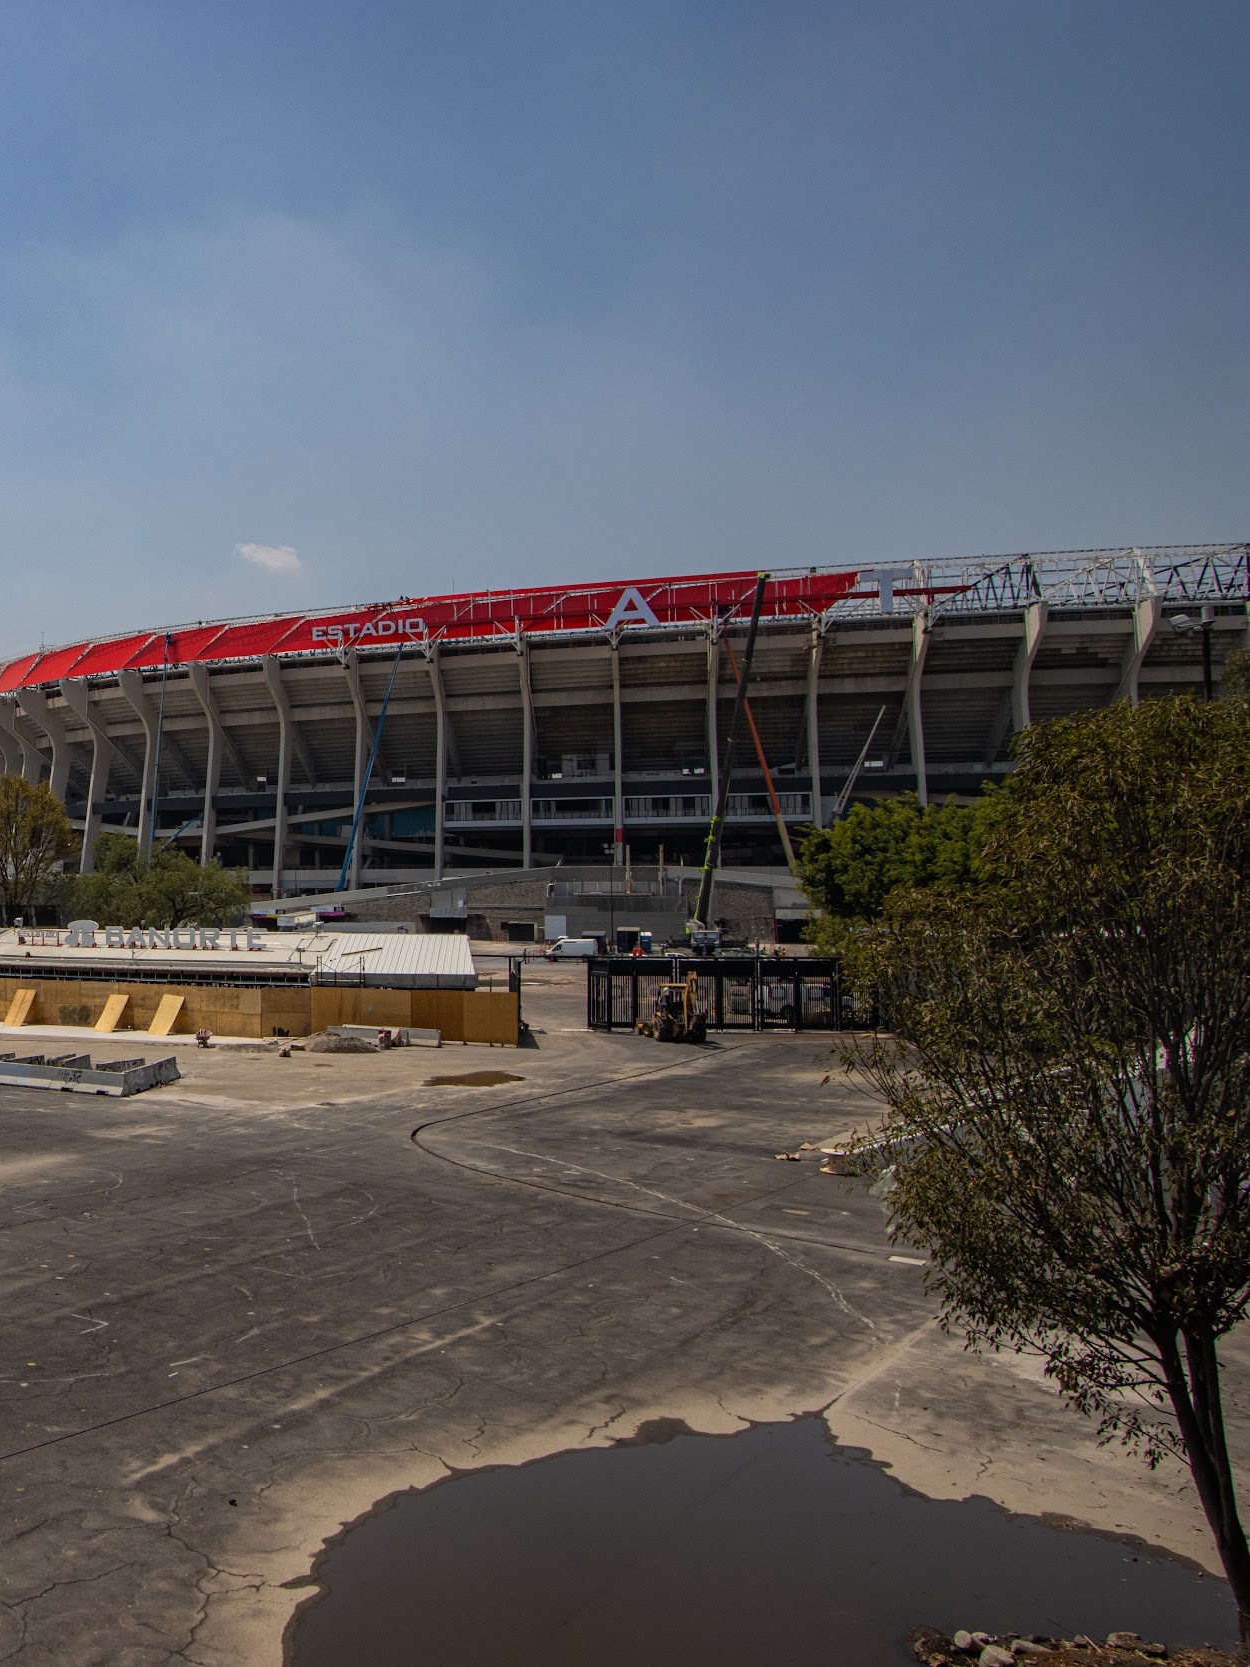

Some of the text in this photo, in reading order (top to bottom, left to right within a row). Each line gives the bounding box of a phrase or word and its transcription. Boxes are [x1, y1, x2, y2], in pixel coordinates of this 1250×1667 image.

[312, 617, 424, 641] ESTADIO
[604, 588, 660, 629] A
[105, 926, 266, 949] BANORTE
